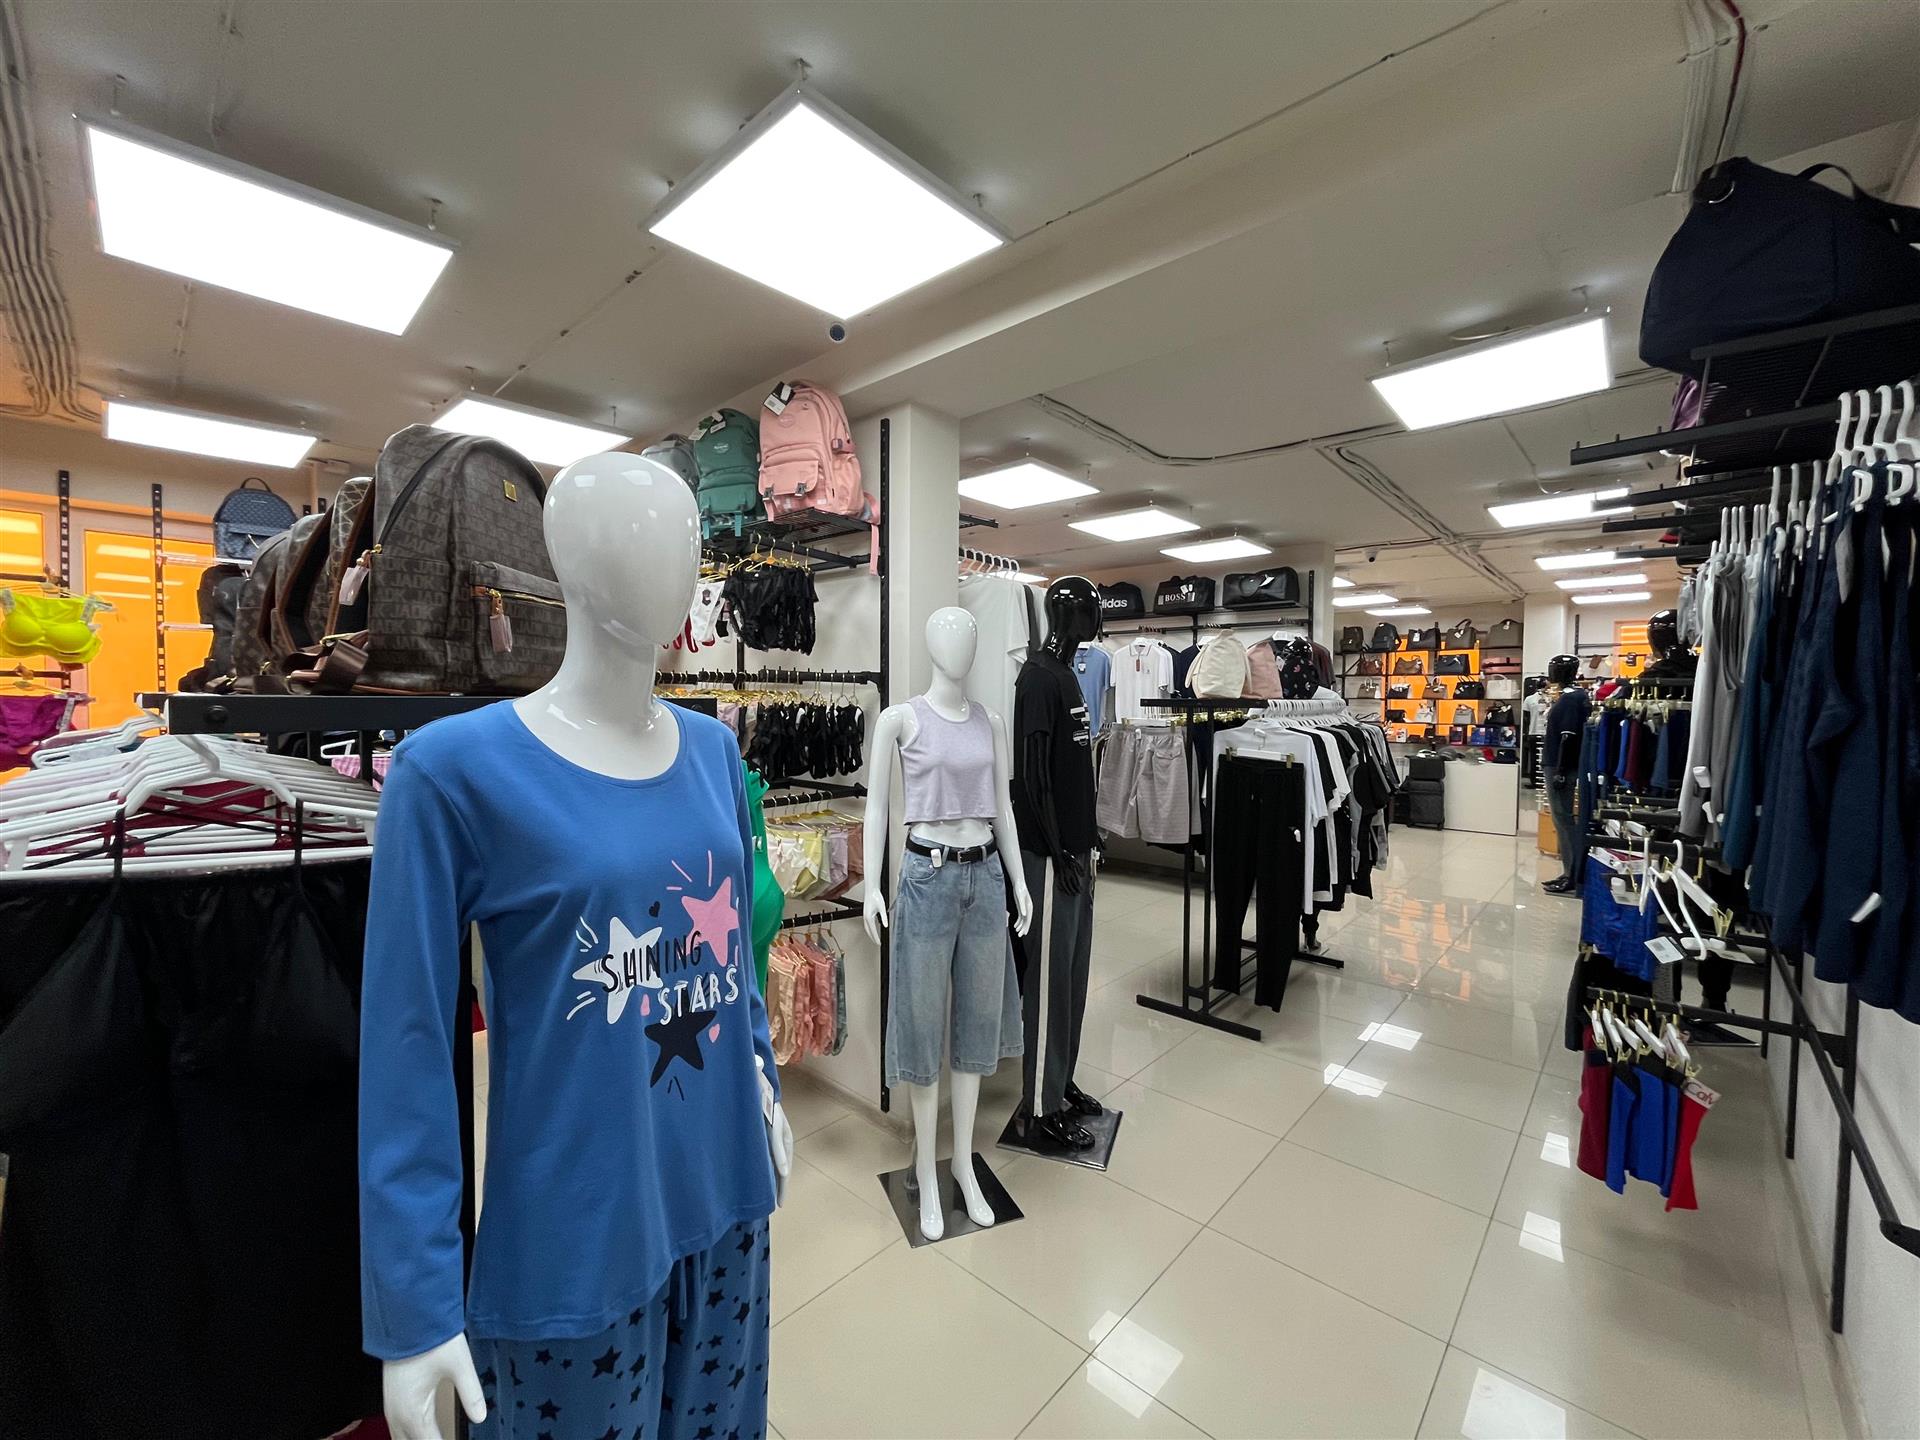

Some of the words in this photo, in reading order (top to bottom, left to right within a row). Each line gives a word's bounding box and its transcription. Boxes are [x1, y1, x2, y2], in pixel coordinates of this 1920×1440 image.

[1165, 593, 1185, 602] BOSS
[602, 931, 701, 993] SHINING
[657, 964, 739, 1025] STARS
